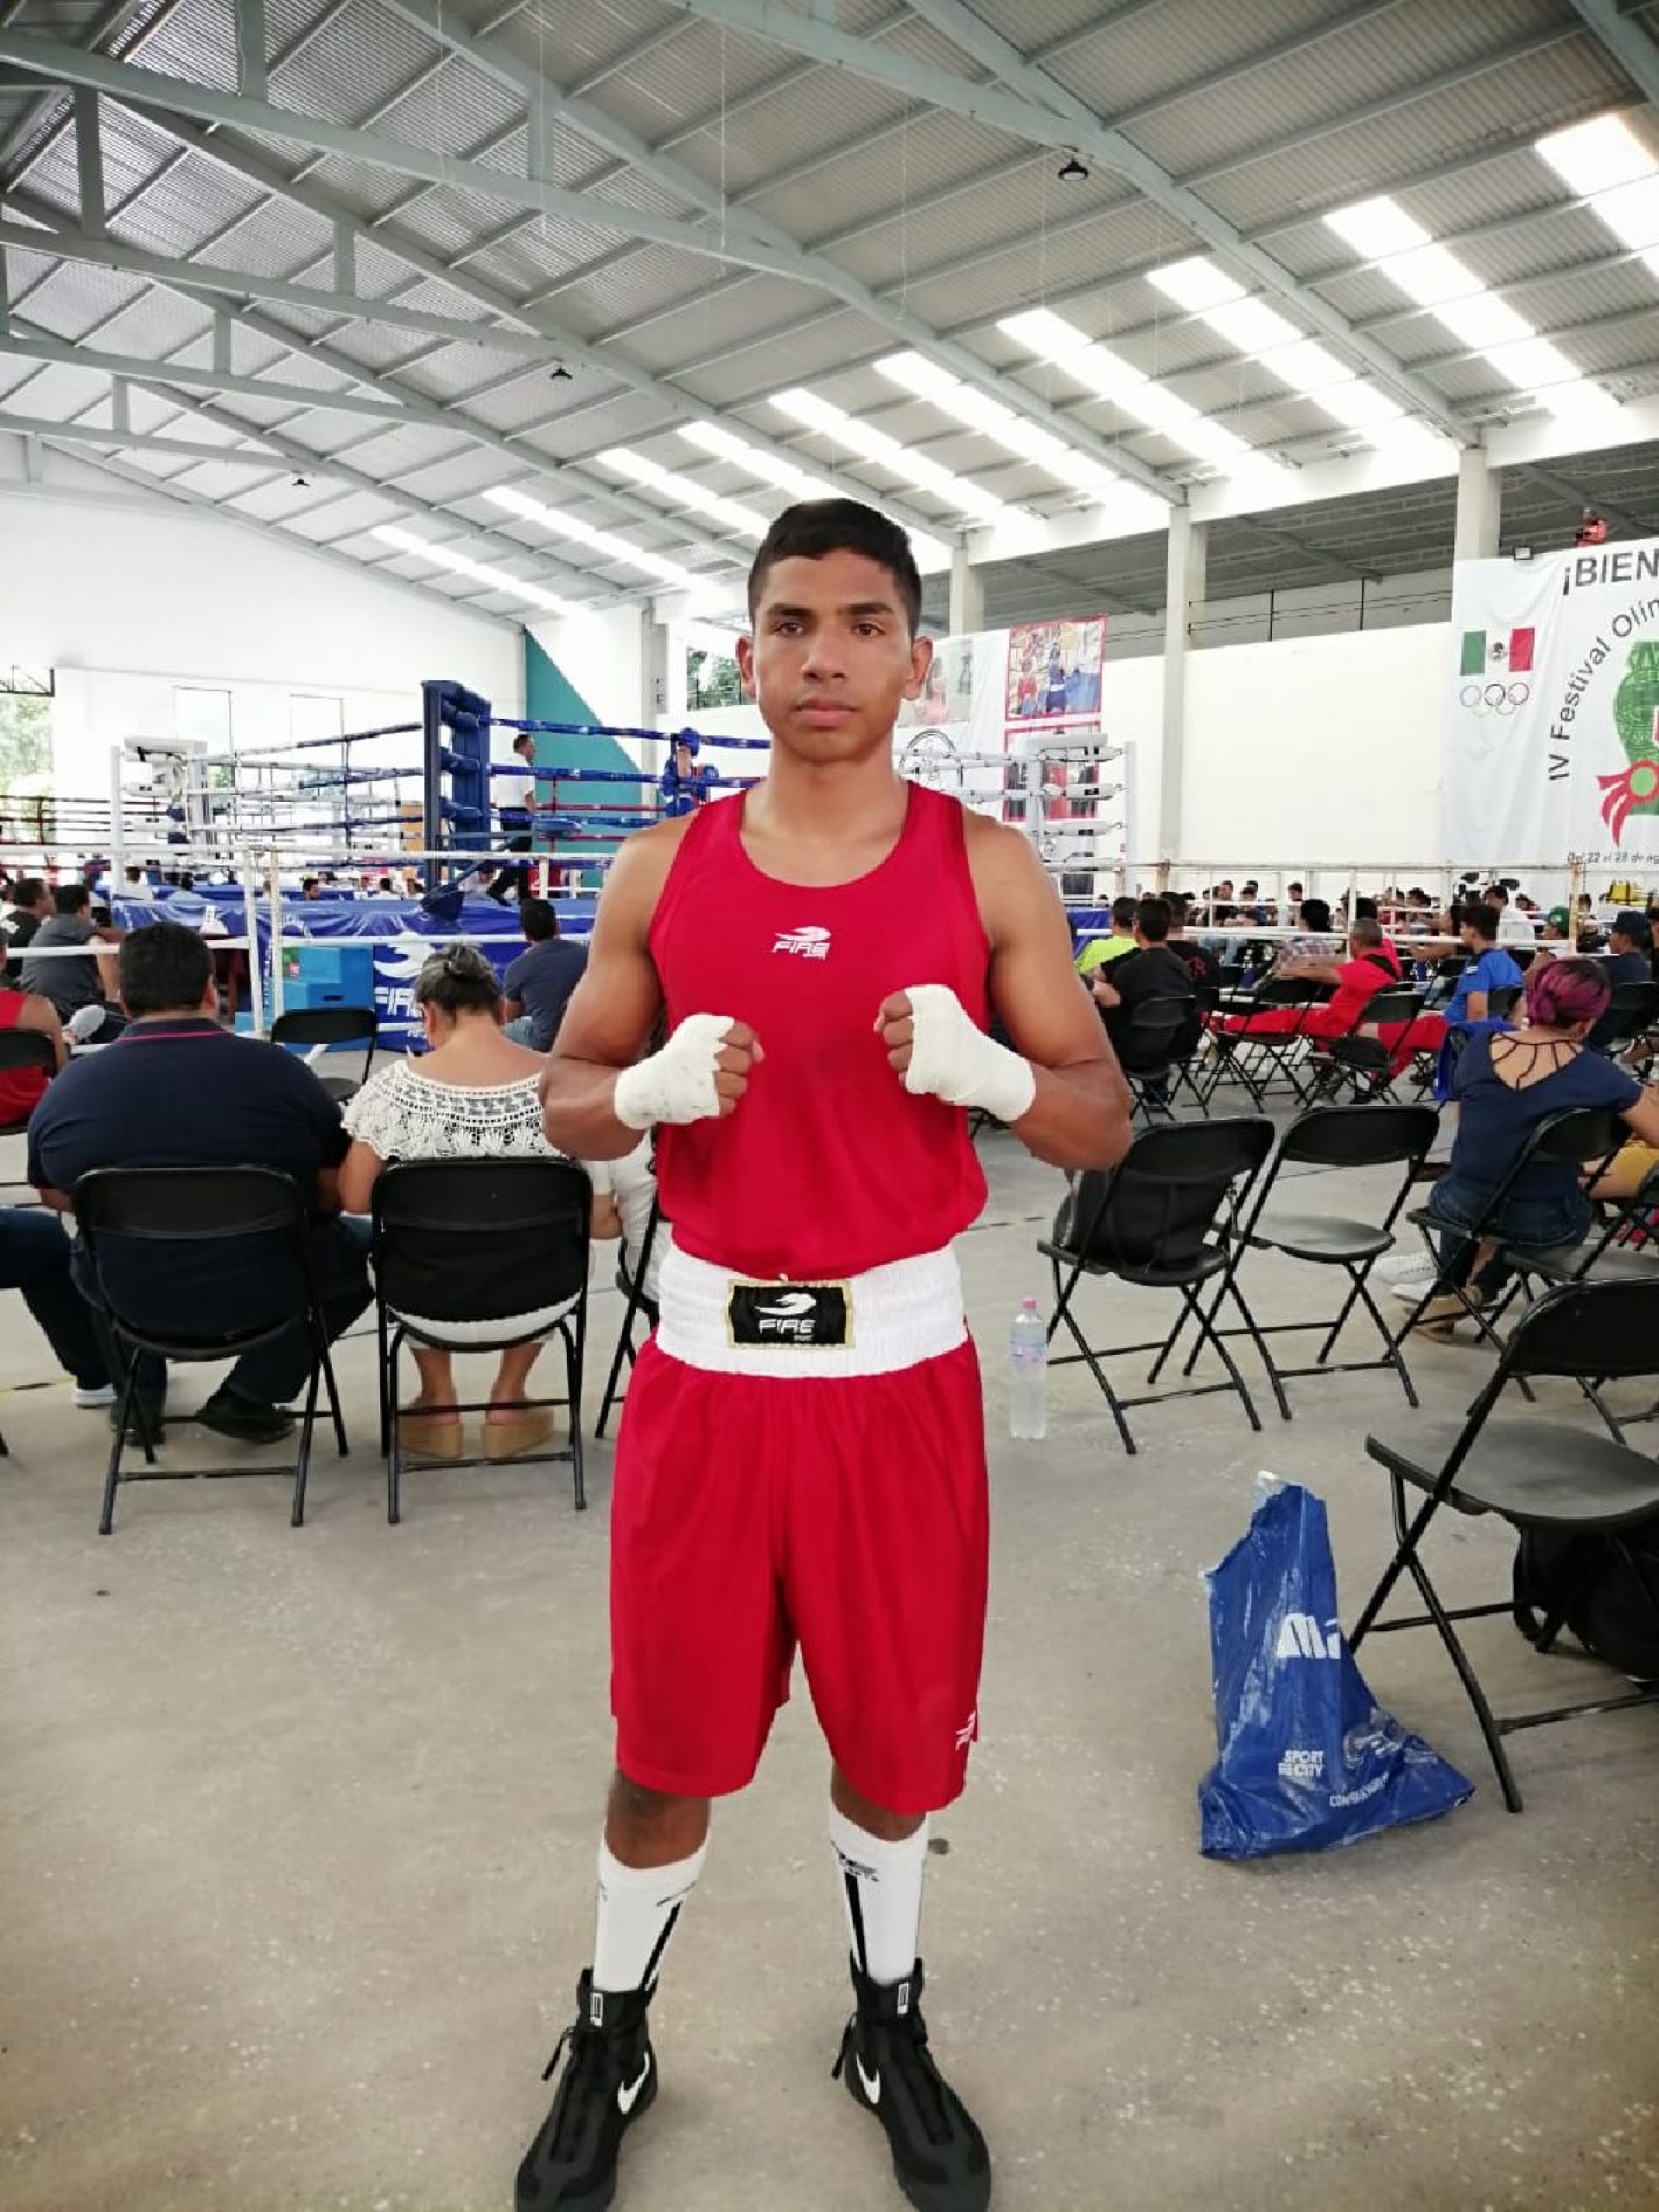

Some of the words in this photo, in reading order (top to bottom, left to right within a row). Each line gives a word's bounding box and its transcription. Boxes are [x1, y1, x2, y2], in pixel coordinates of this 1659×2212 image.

[1550, 636, 1611, 741] Festival
[1548, 753, 1570, 781] IV
[375, 986, 423, 1018] FIR
[758, 1319, 817, 1335] FIRE
